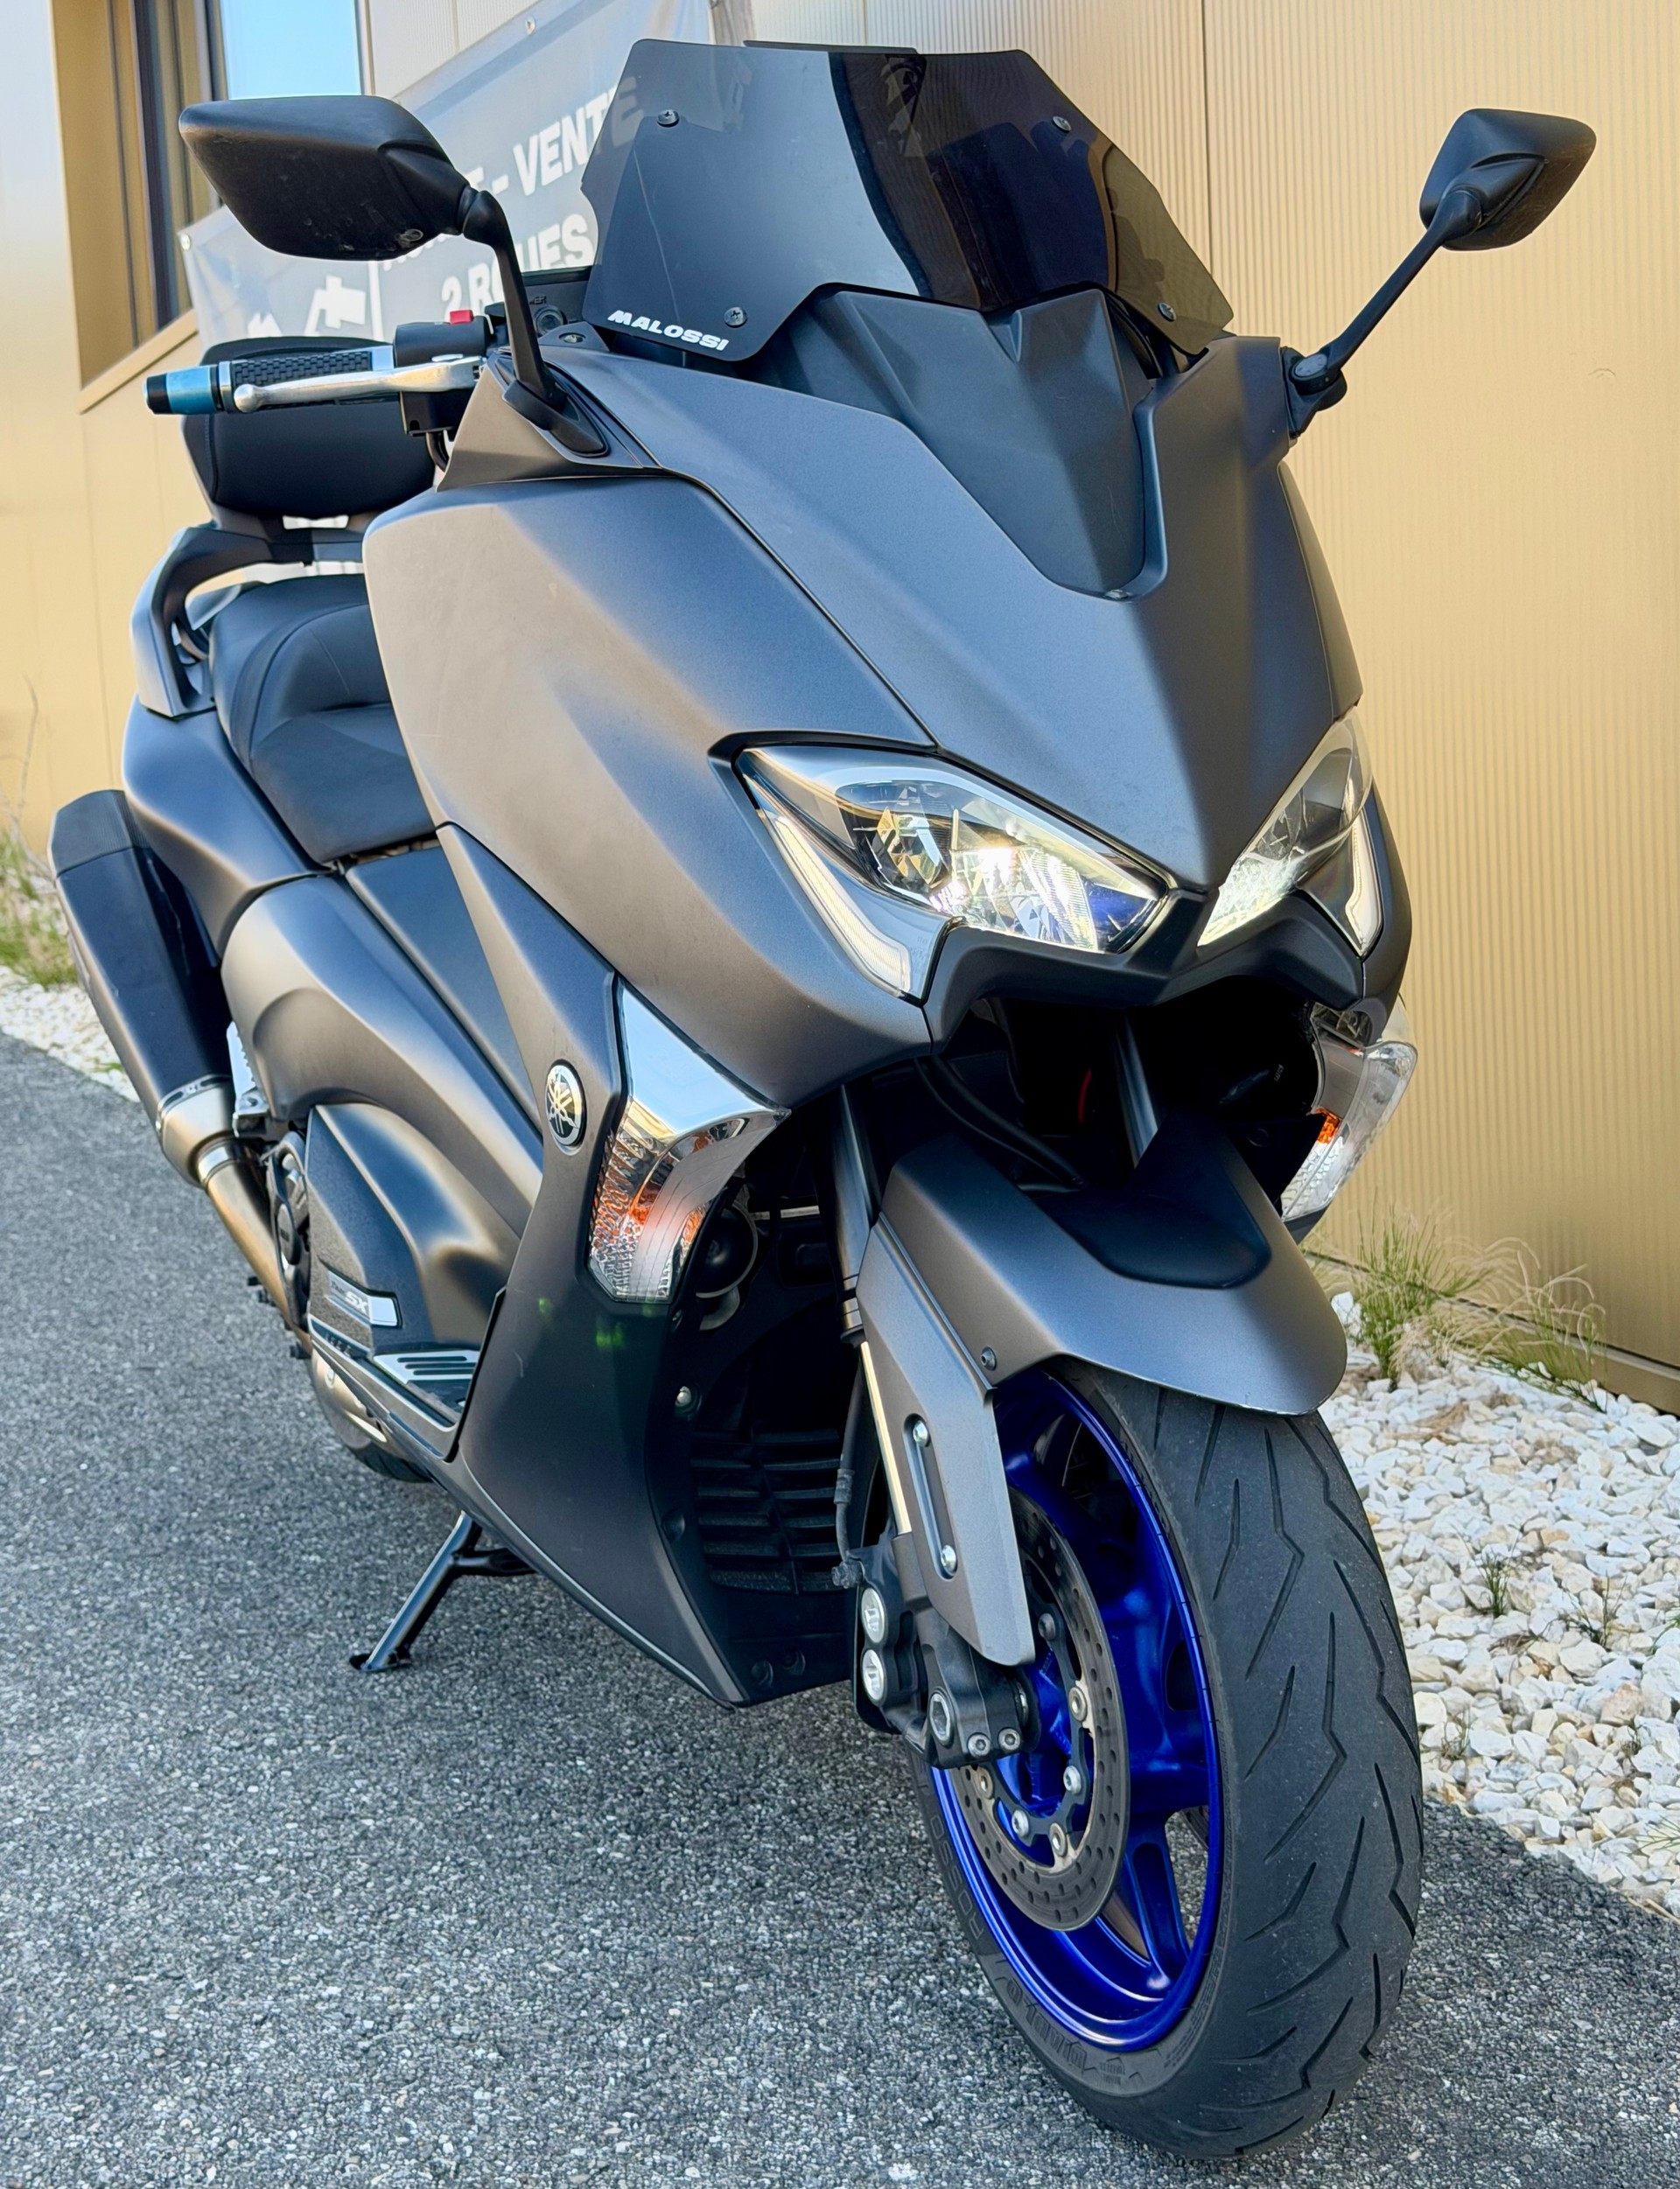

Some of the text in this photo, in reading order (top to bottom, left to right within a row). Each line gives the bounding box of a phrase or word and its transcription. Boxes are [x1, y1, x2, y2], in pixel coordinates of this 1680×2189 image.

[513, 76, 644, 196] VENTE
[442, 276, 462, 323] 2
[607, 310, 730, 351] MALOSSI
[345, 1291, 368, 1313] SX
[930, 1816, 984, 1940] ROSSO
